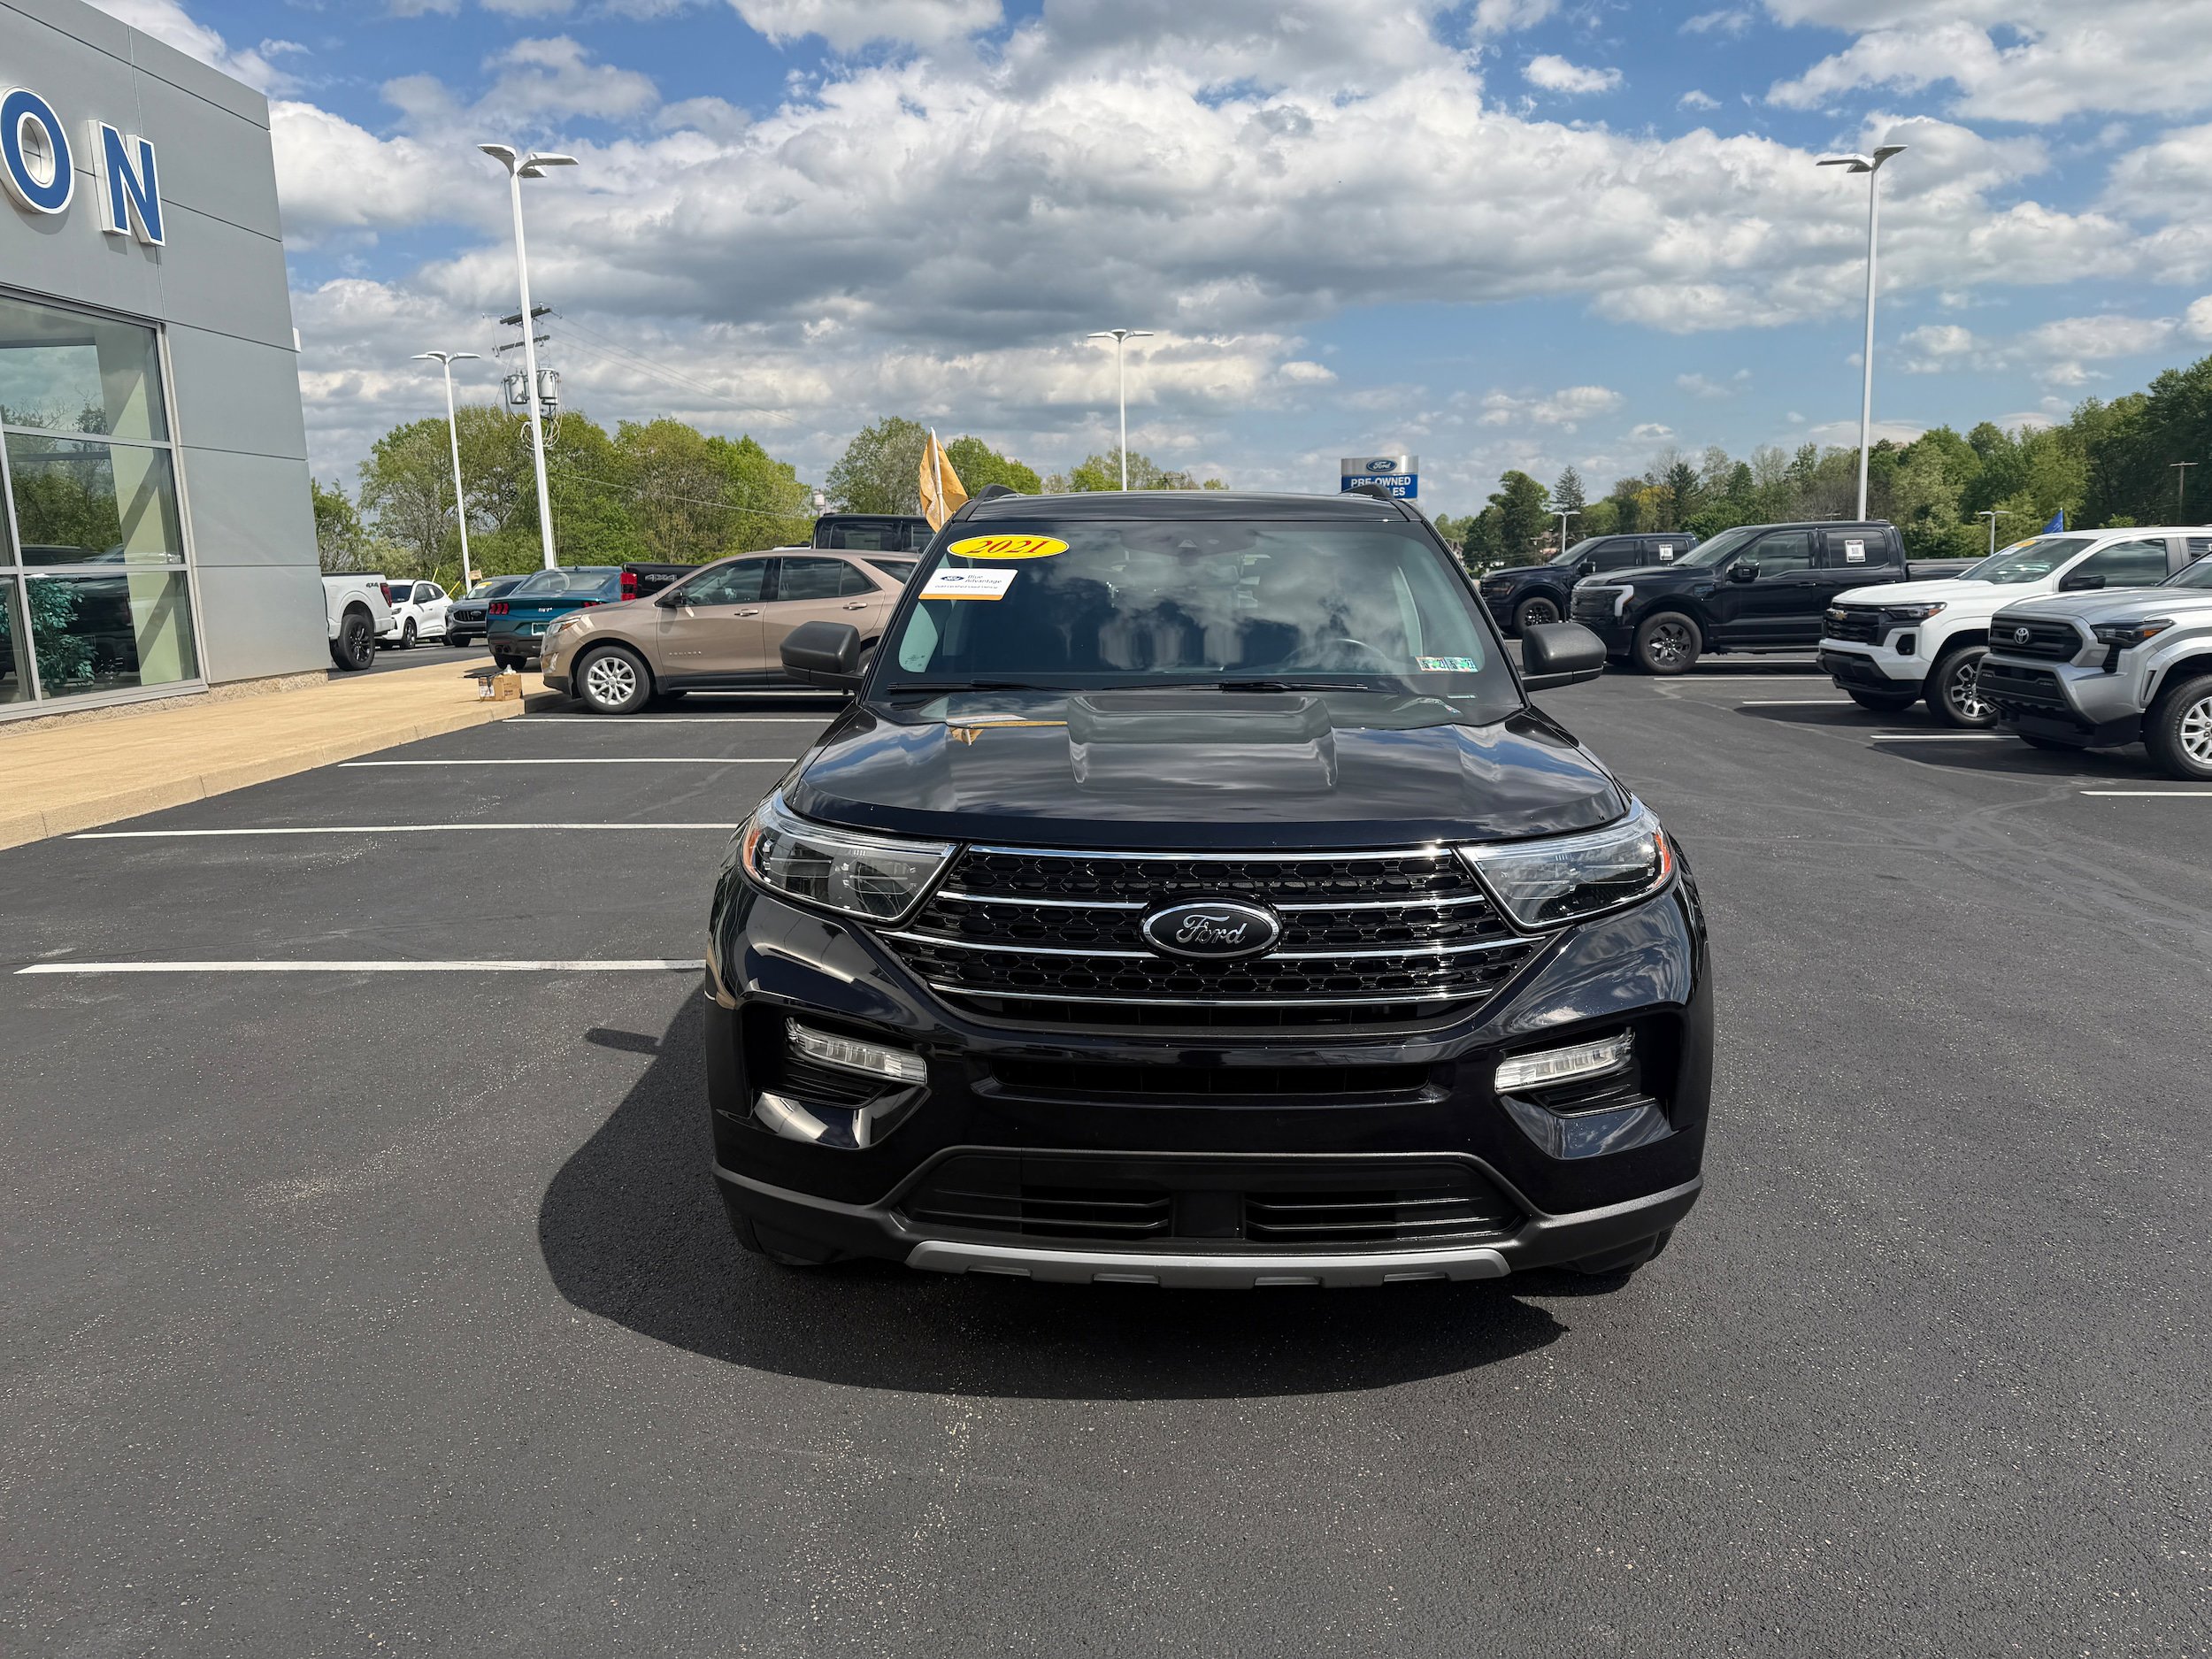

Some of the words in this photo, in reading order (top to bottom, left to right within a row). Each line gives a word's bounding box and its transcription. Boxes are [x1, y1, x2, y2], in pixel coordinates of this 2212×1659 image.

[1350, 476, 1411, 488] PRE-OWNED
[965, 540, 1050, 554] 2021
[1175, 914, 1248, 944] Ford
